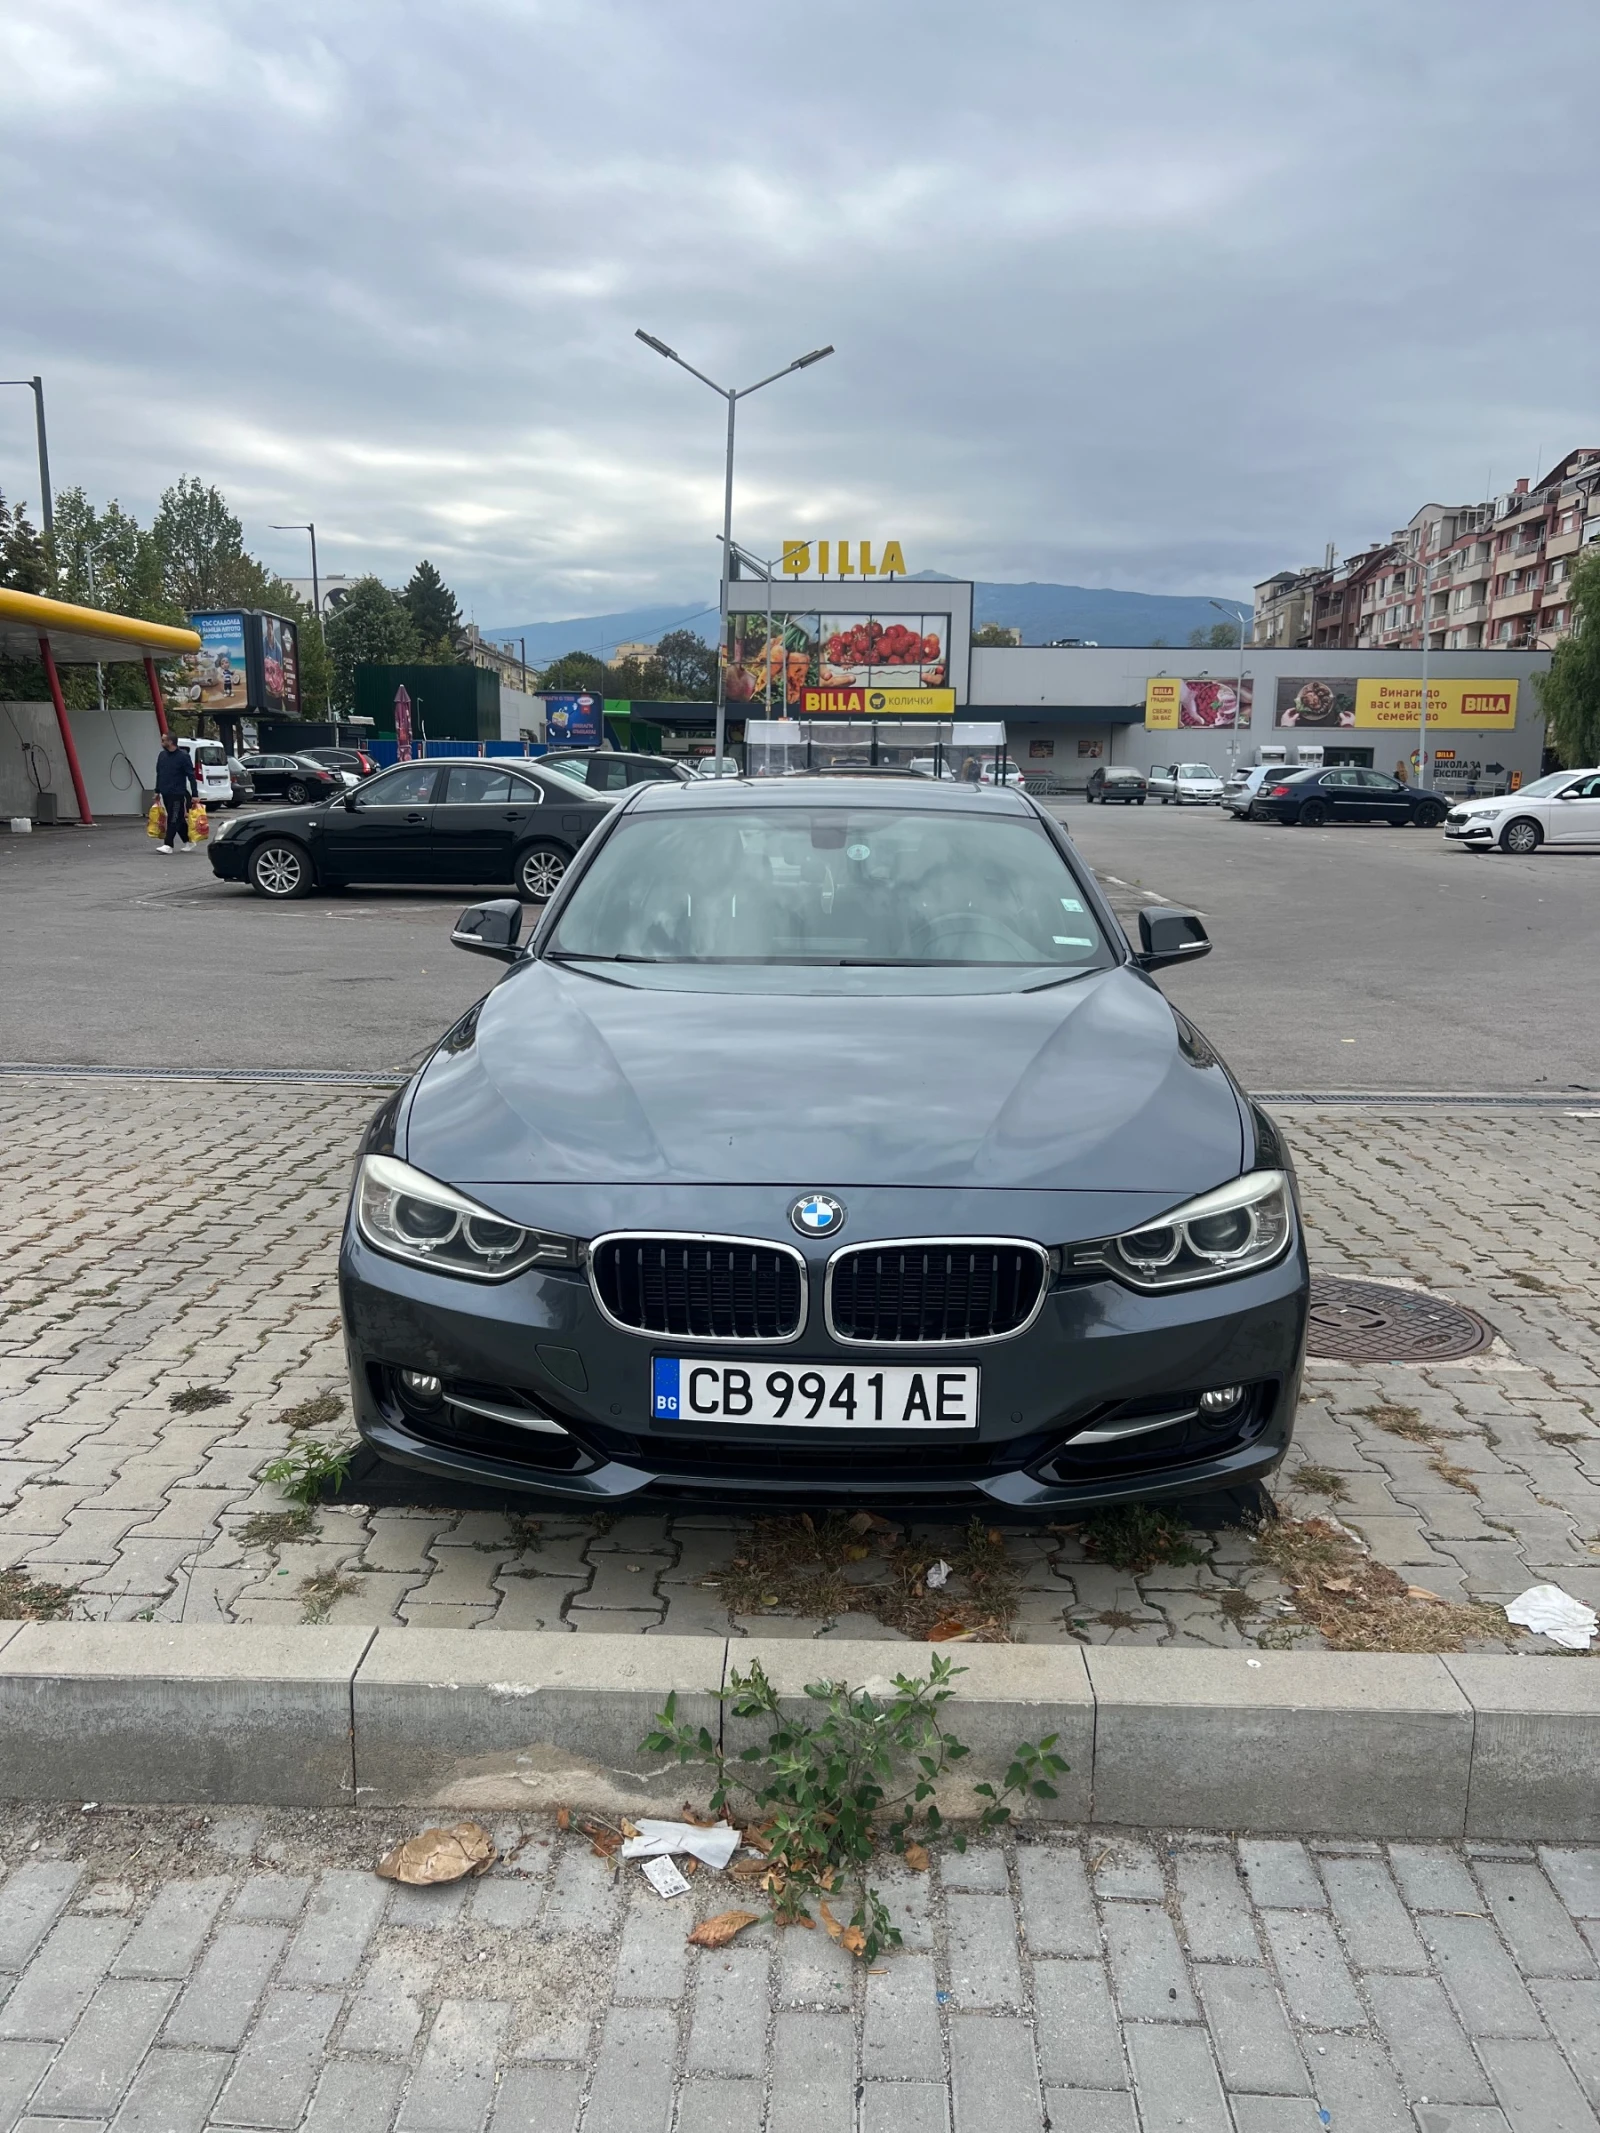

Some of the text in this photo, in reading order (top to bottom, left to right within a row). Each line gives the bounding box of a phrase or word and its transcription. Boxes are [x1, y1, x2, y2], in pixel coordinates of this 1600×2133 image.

[783, 541, 907, 575] BILLA
[1380, 687, 1440, 699] Винаги до
[805, 692, 861, 711] BILLA
[888, 696, 933, 706] КОЛИЧКИ
[1370, 700, 1390, 710] вас
[1393, 701, 1401, 710] и
[1465, 697, 1506, 712] BILLA
[1434, 760, 1468, 769] ШКОЛА
[1433, 769, 1481, 778] ЕКСПЕР
[689, 1367, 967, 1422] CB 9941 AE
[657, 1396, 677, 1410] BG
